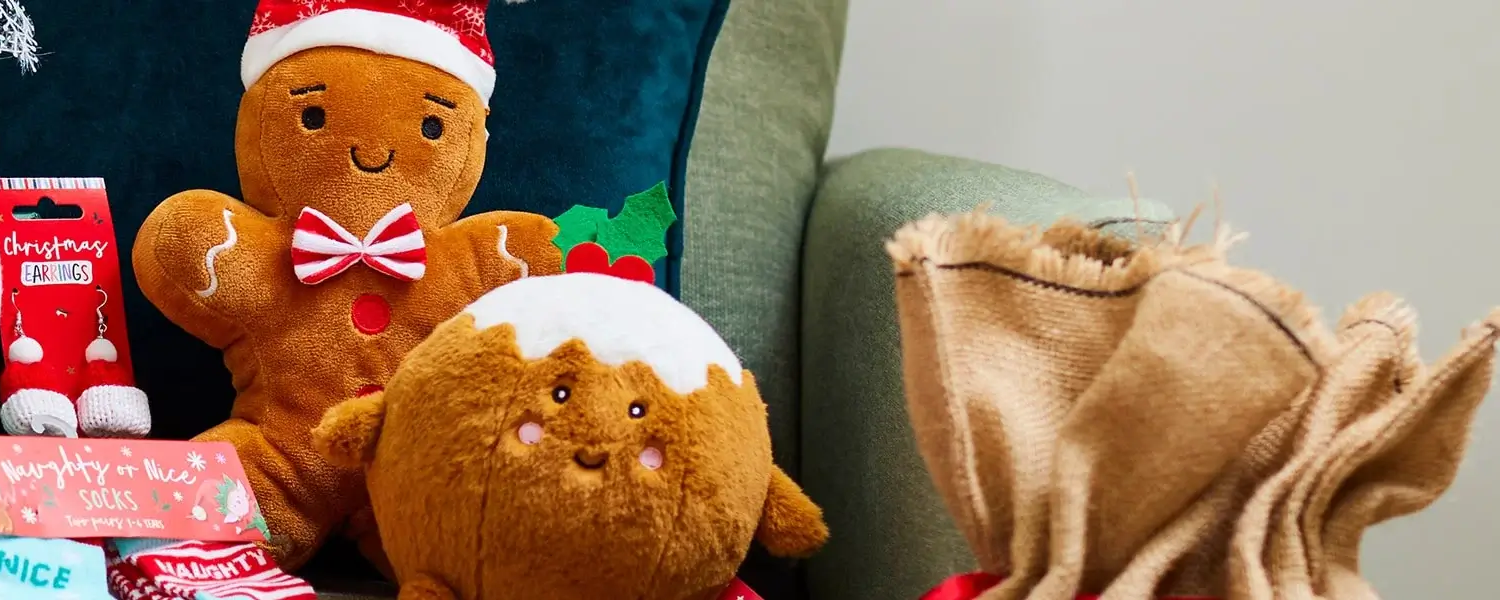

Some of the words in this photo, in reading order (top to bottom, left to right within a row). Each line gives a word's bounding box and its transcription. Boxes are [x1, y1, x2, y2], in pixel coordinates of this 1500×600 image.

[4, 230, 108, 260] Christmas
[24, 263, 89, 284] EARRINGS
[0, 445, 110, 489] Naughty
[116, 465, 139, 478] or
[143, 458, 197, 485] Nice
[78, 487, 138, 511] SOCKS
[154, 548, 268, 579] NAUGHTY
